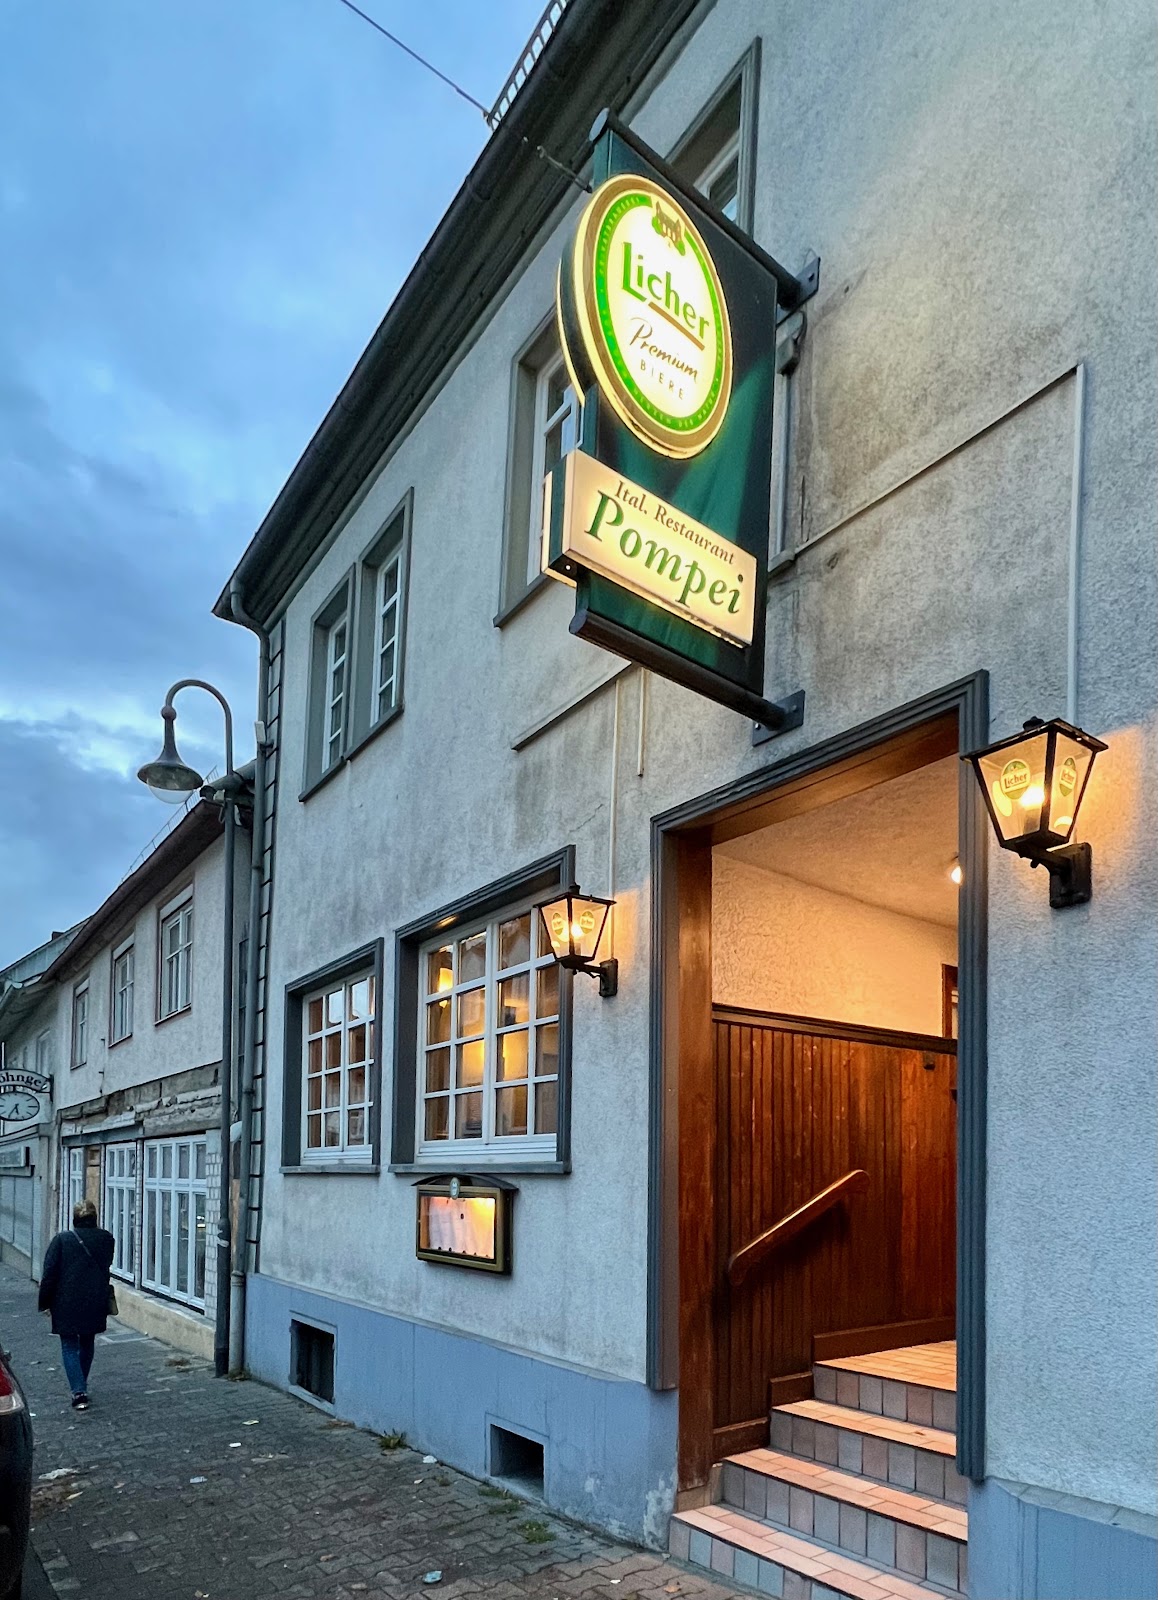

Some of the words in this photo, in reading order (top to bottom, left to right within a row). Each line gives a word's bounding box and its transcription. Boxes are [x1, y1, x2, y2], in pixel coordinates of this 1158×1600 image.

[621, 241, 710, 340] Licher
[629, 316, 699, 384] Premium
[639, 358, 684, 400] BIERE
[584, 489, 744, 614] Pompei
[614, 479, 648, 515] Ital.
[654, 503, 736, 565] Restaurant
[1004, 772, 1028, 789] Licher
